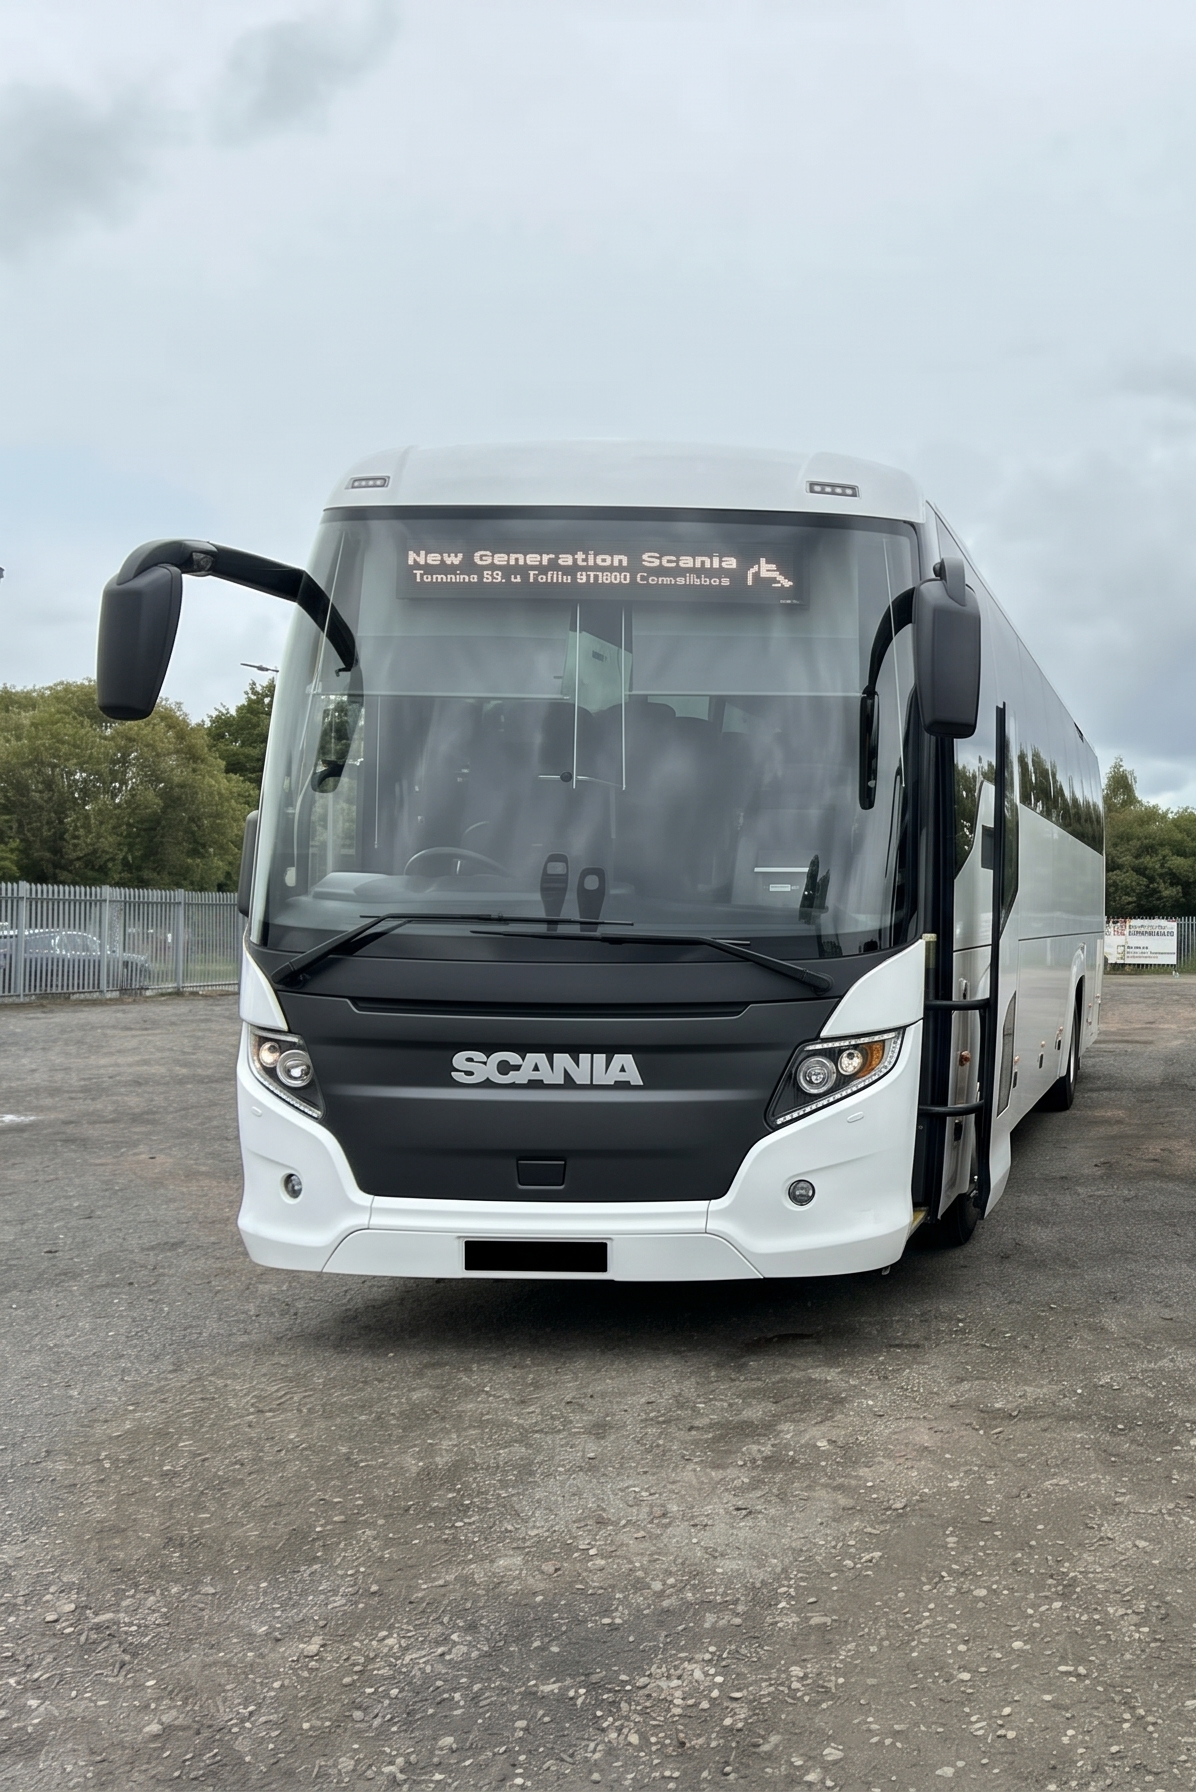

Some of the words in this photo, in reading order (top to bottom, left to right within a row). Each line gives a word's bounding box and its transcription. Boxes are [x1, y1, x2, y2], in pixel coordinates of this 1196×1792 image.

[407, 550, 463, 566] New
[473, 550, 629, 567] Generation
[641, 552, 737, 569] Scania
[451, 1050, 644, 1086] SCANIA
